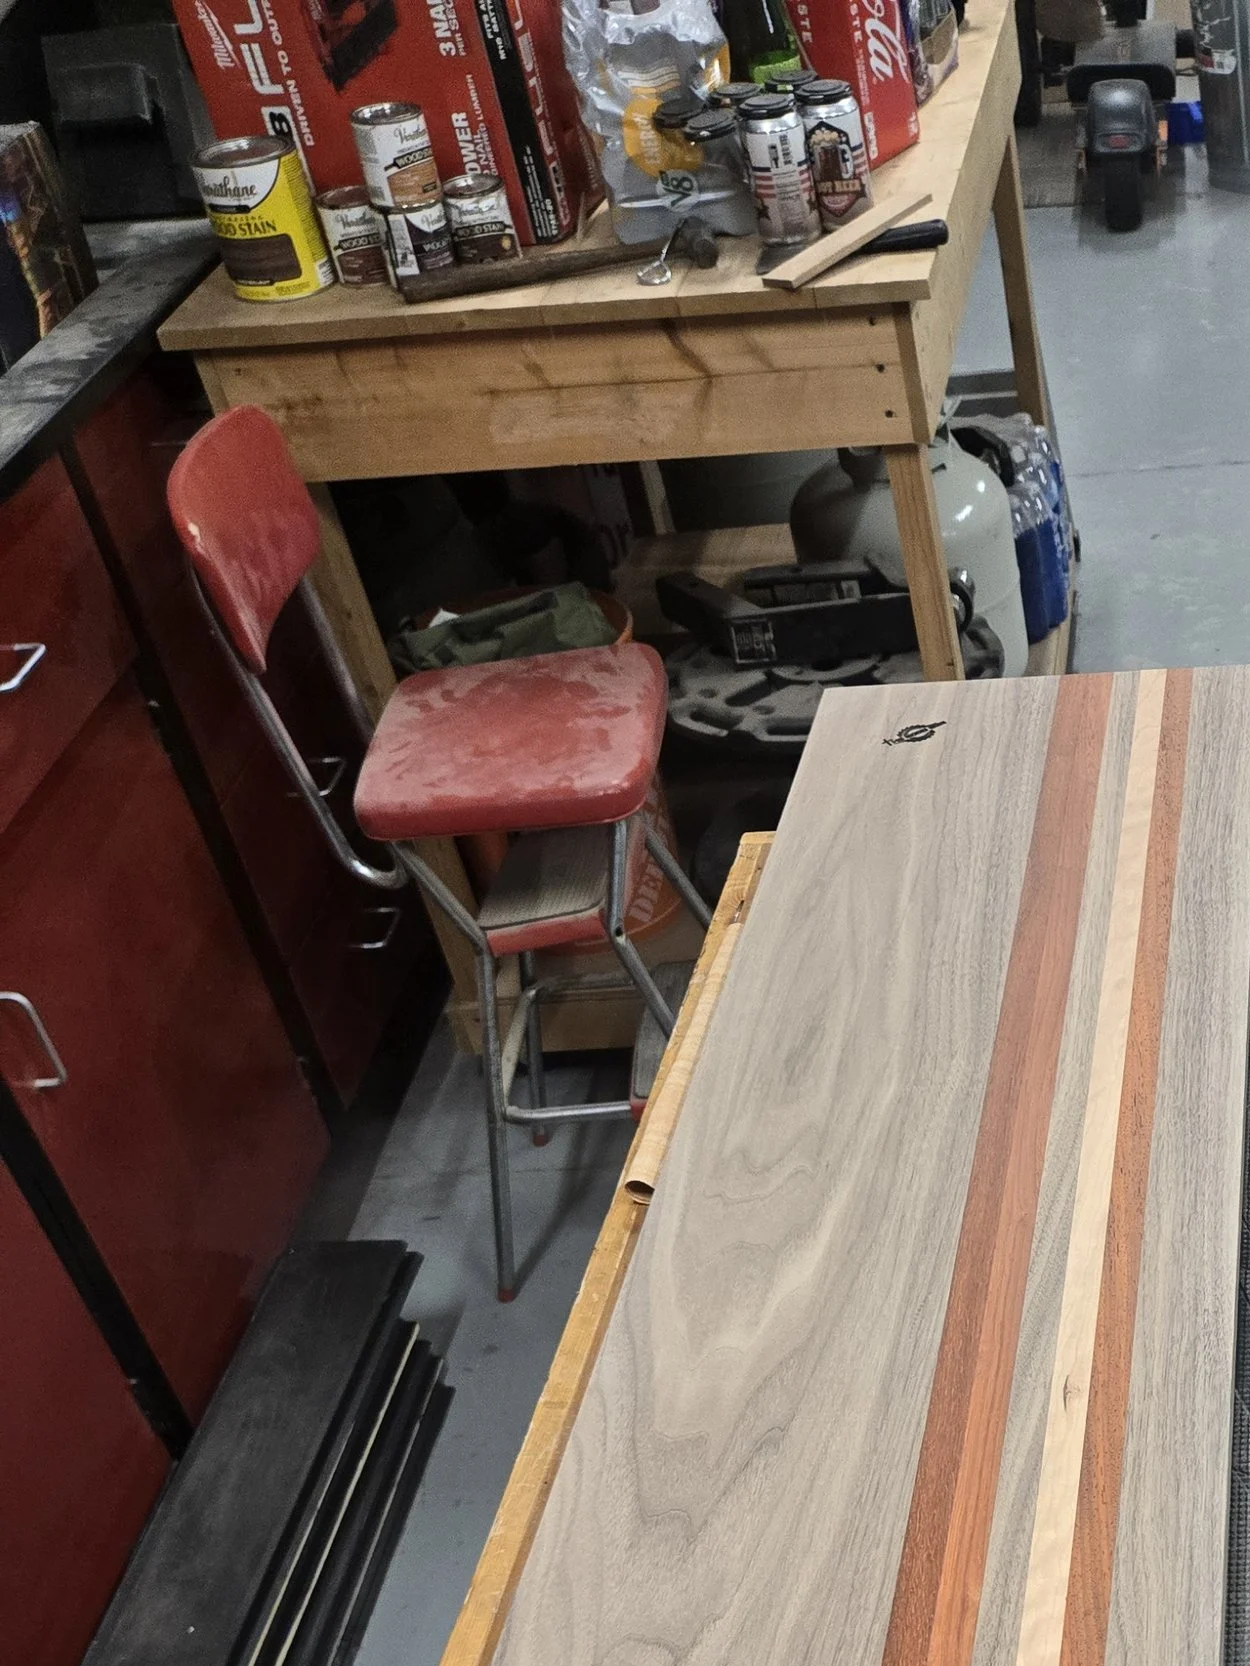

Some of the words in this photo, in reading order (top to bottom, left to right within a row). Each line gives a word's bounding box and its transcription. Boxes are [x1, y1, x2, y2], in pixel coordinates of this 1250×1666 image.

[439, 41, 456, 57] 3
[455, 34, 467, 56] PER
[277, 50, 293, 76] TO
[465, 73, 484, 120] LUMBER
[286, 80, 315, 146] DRIVEN
[451, 112, 482, 174] OWER
[238, 219, 277, 236] STAIN
